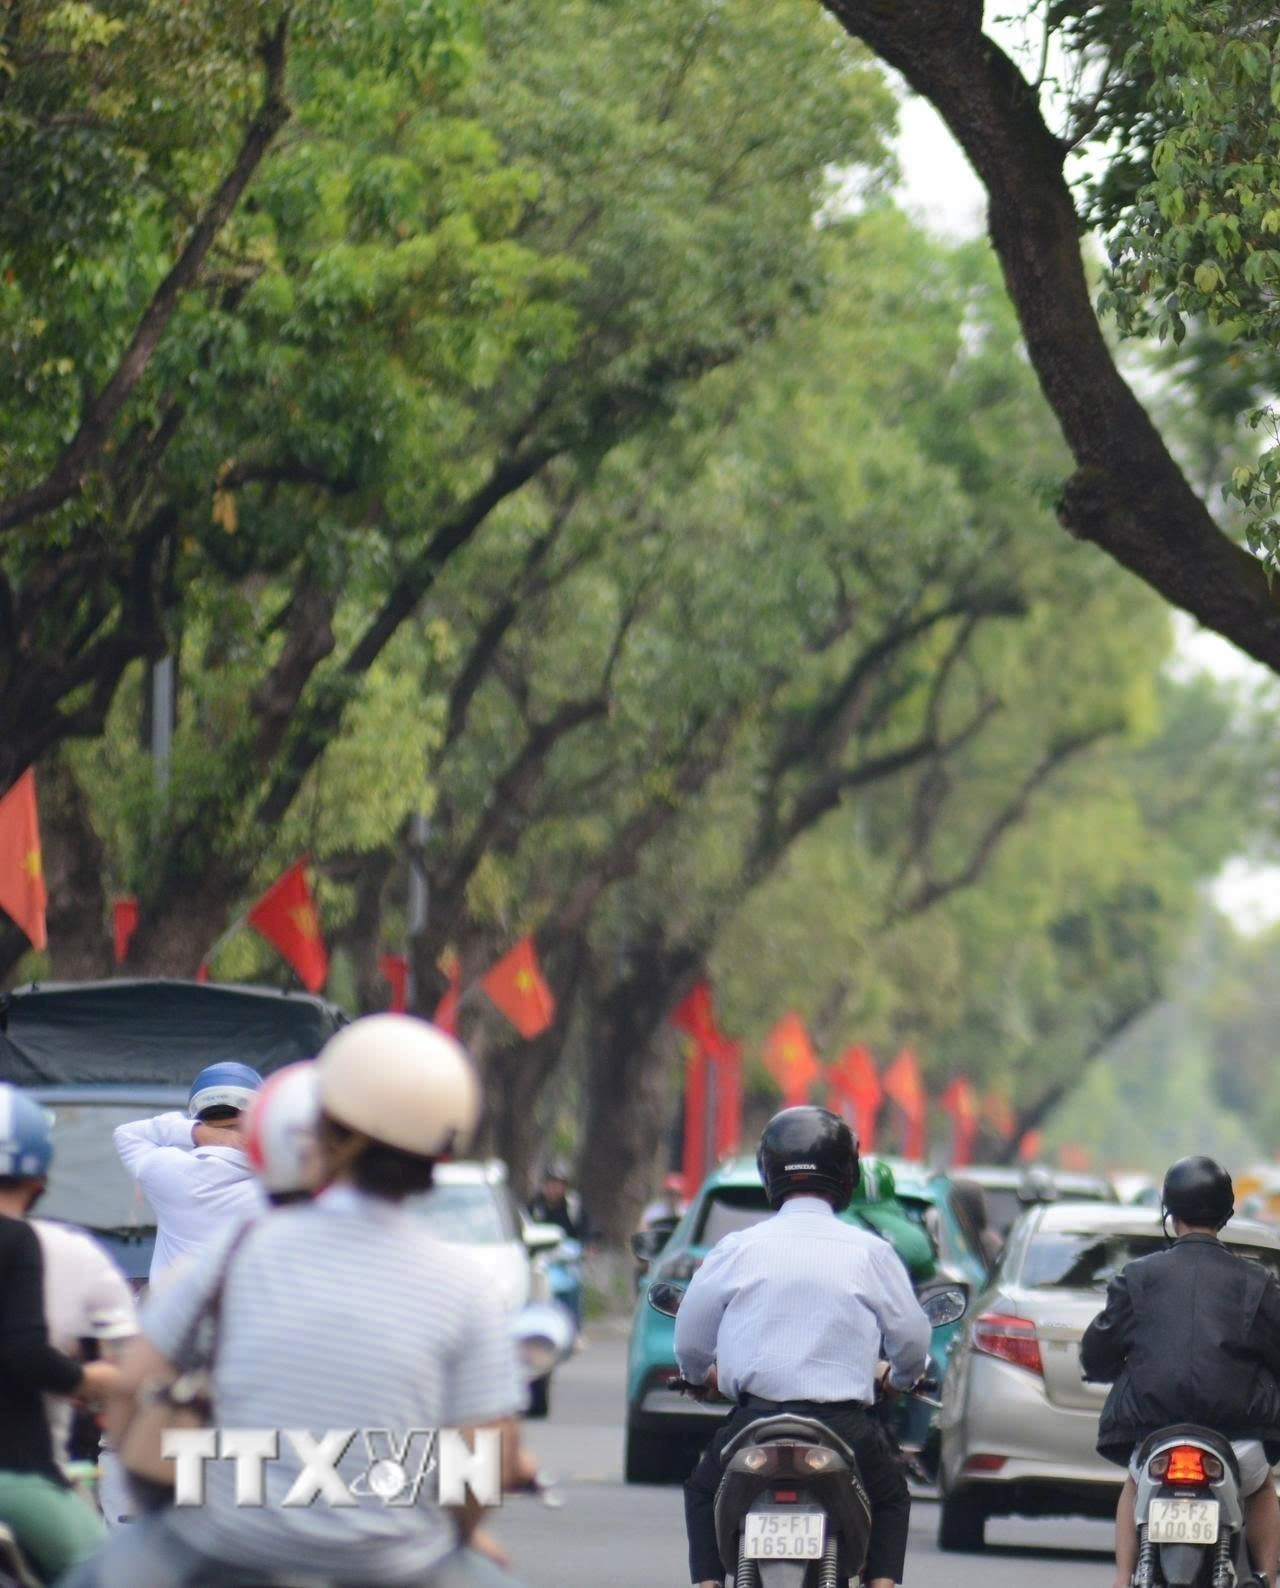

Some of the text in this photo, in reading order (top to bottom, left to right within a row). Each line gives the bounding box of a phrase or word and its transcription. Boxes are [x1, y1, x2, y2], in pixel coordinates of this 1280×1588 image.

[784, 1163, 817, 1171] HONDA
[1160, 1503, 1208, 1521] 75-F2
[758, 1516, 811, 1535] 75-F1
[1153, 1521, 1213, 1540] 100.96
[751, 1537, 819, 1556] 165.05
